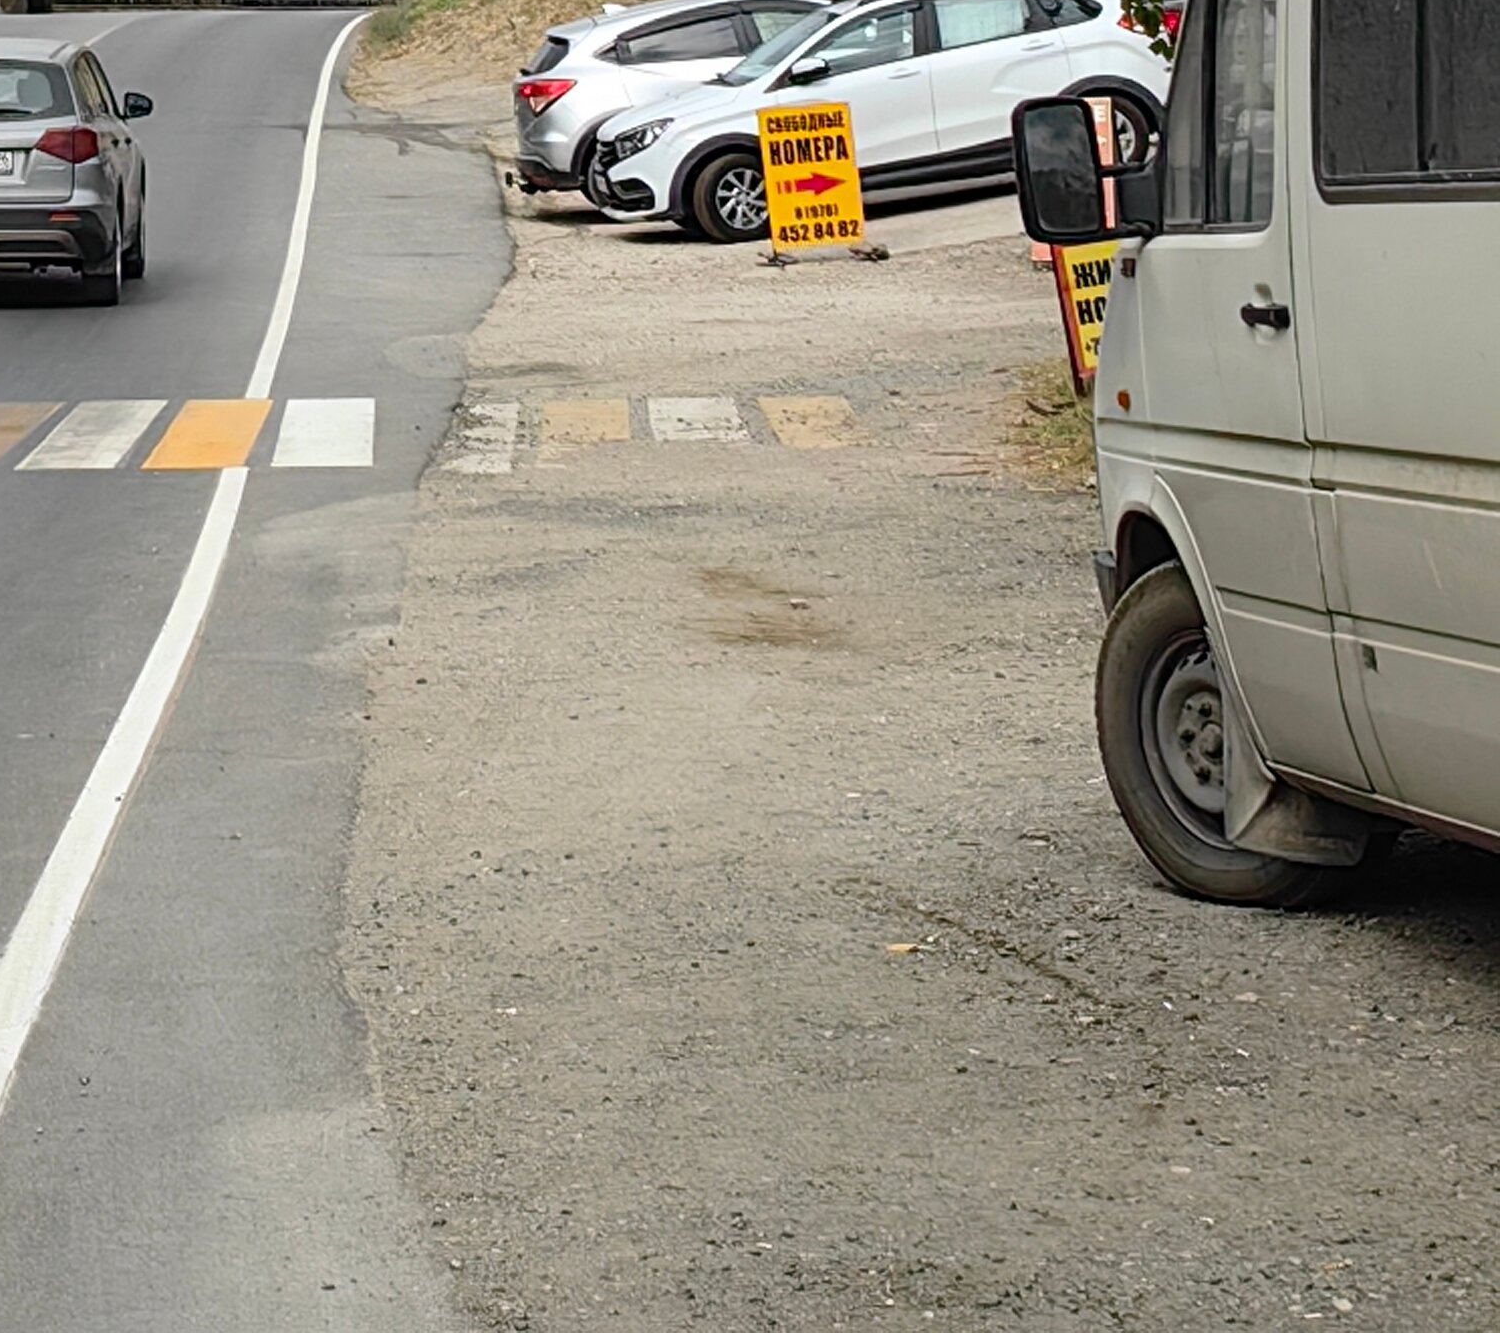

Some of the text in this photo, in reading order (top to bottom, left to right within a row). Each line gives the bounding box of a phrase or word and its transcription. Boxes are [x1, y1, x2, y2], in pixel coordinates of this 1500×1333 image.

[766, 111, 845, 134] СВОБОДНЫЕ
[769, 135, 849, 165] НОМЕРА
[778, 219, 860, 243] 452 84 82
[1072, 258, 1114, 289] ЖИ
[1076, 296, 1108, 326] НО
